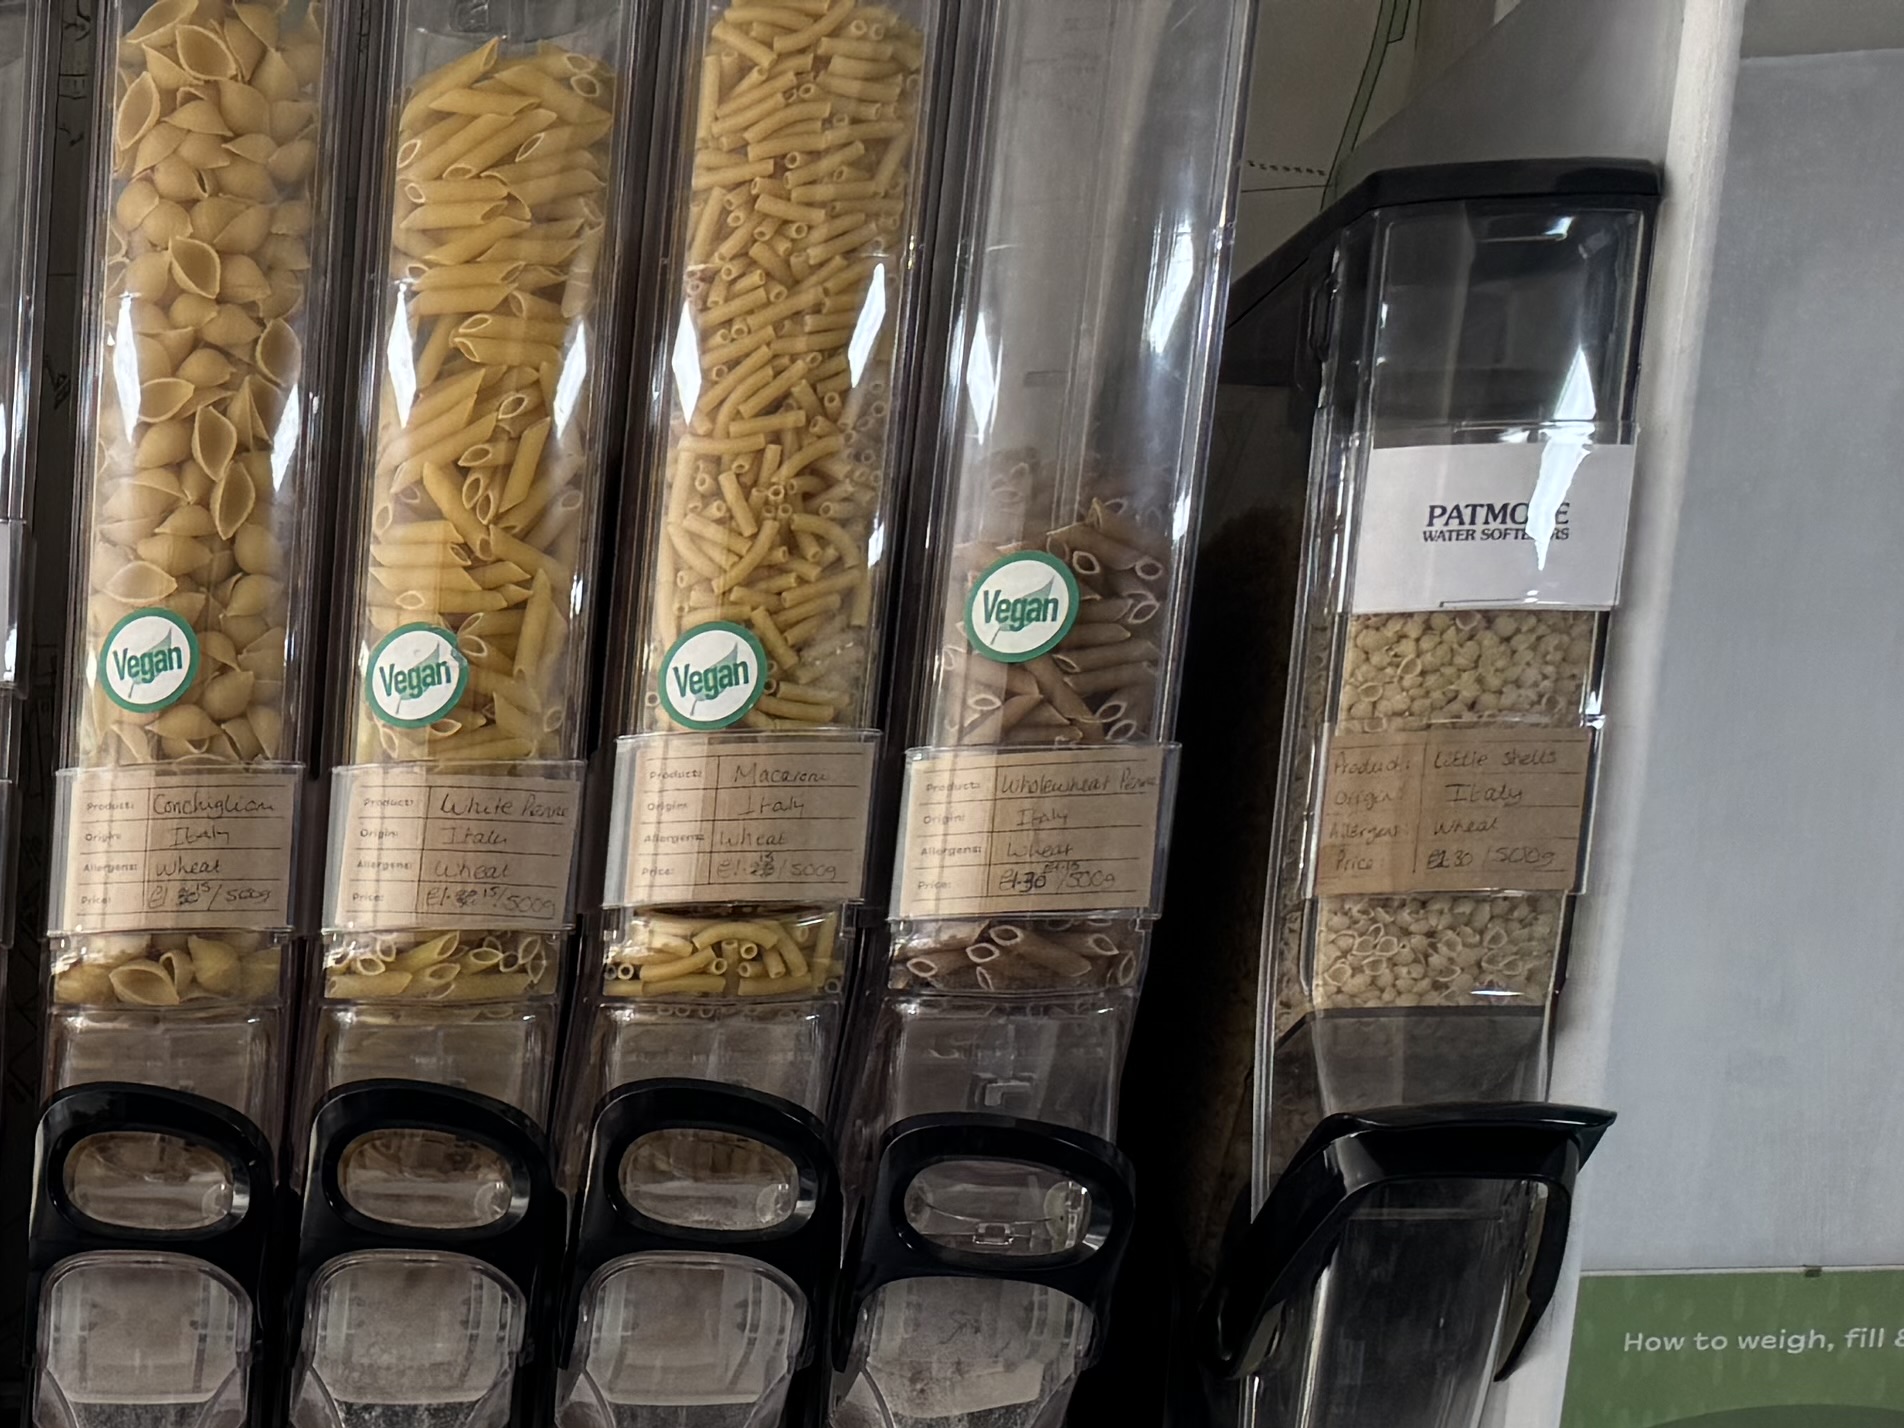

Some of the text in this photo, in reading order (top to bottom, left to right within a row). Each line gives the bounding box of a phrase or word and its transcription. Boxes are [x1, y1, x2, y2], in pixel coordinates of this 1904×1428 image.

[1426, 502, 1570, 528] PATMOE
[1422, 529, 1476, 543] WATER
[983, 589, 1059, 632] Vegan
[112, 645, 183, 684] Vegan
[379, 660, 453, 700] Vegan
[672, 659, 749, 699] Vegan
[1623, 1327, 1884, 1354] How to weigh, fill
